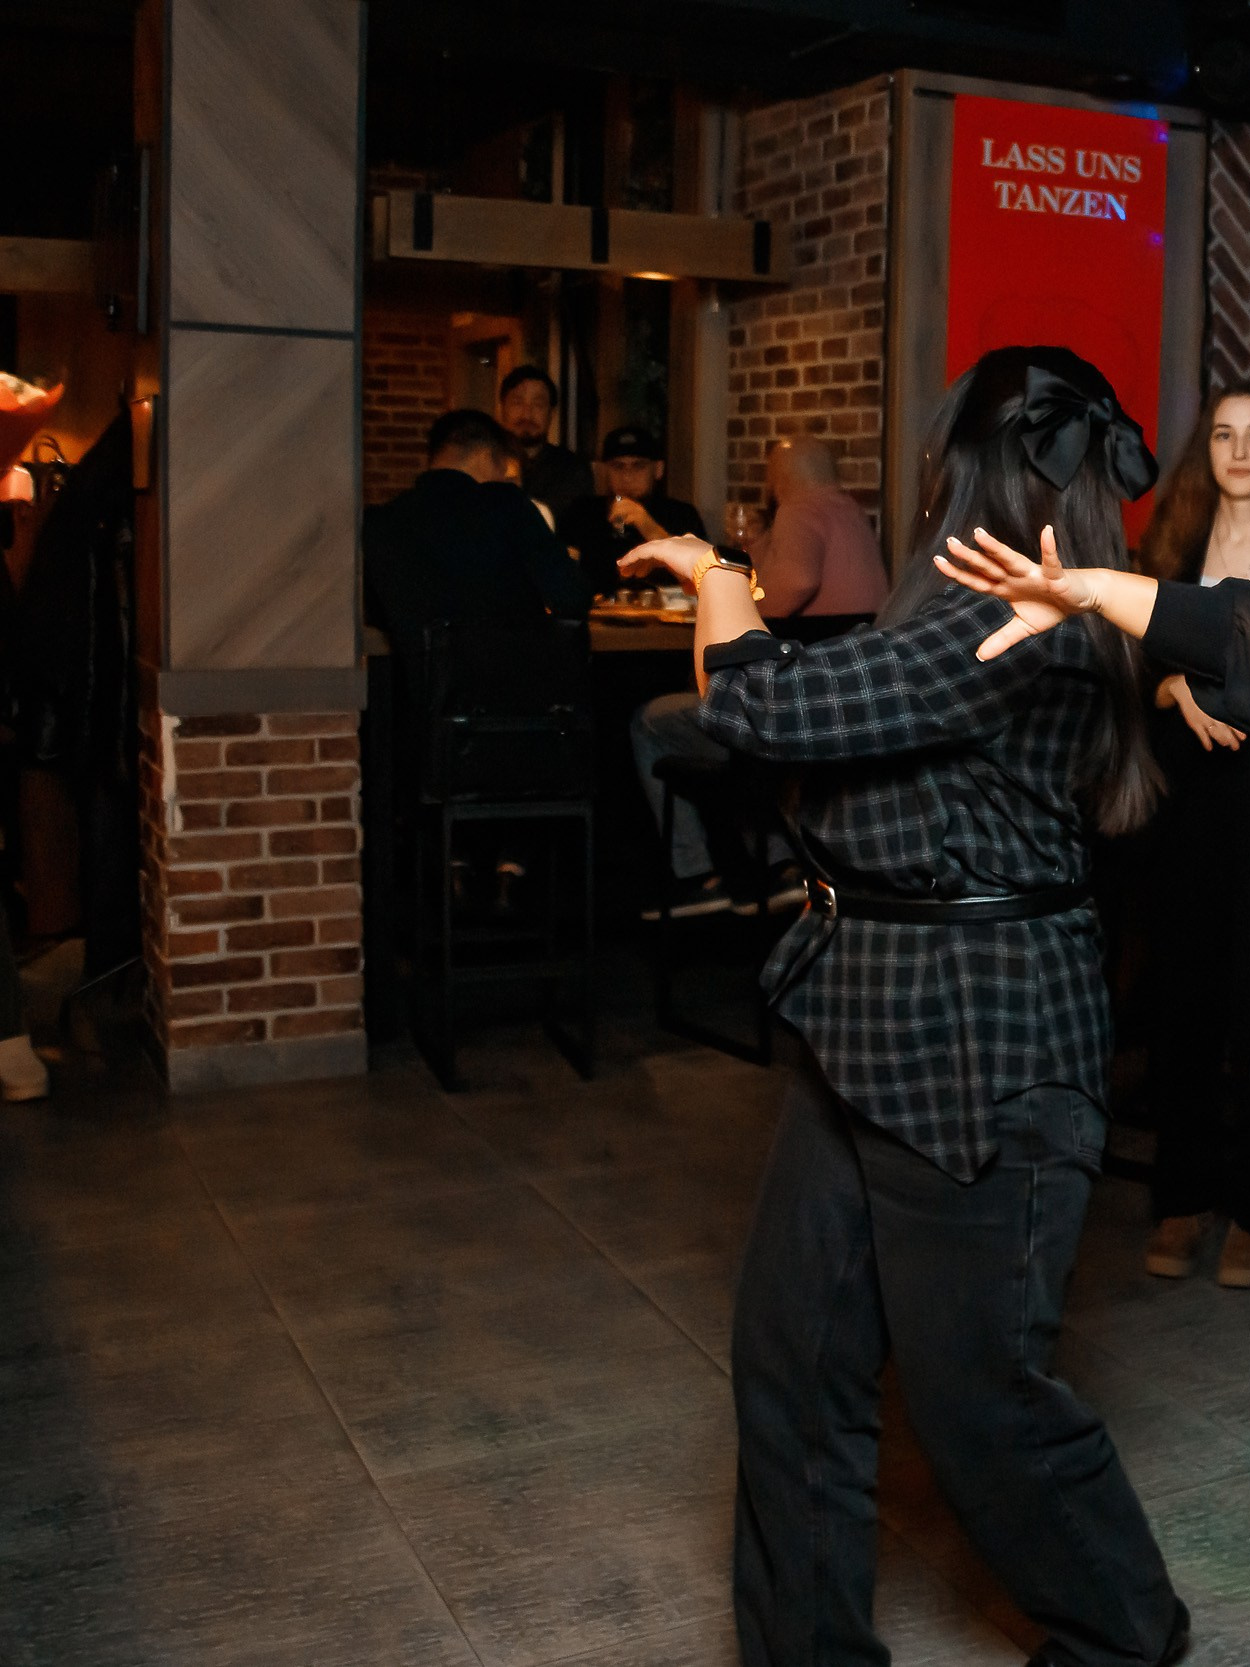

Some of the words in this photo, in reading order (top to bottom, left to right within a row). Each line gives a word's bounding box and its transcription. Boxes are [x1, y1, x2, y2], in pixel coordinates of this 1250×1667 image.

[982, 138, 1066, 174] LASS
[1076, 150, 1142, 183] UNS
[994, 181, 1128, 221] TANZEN
